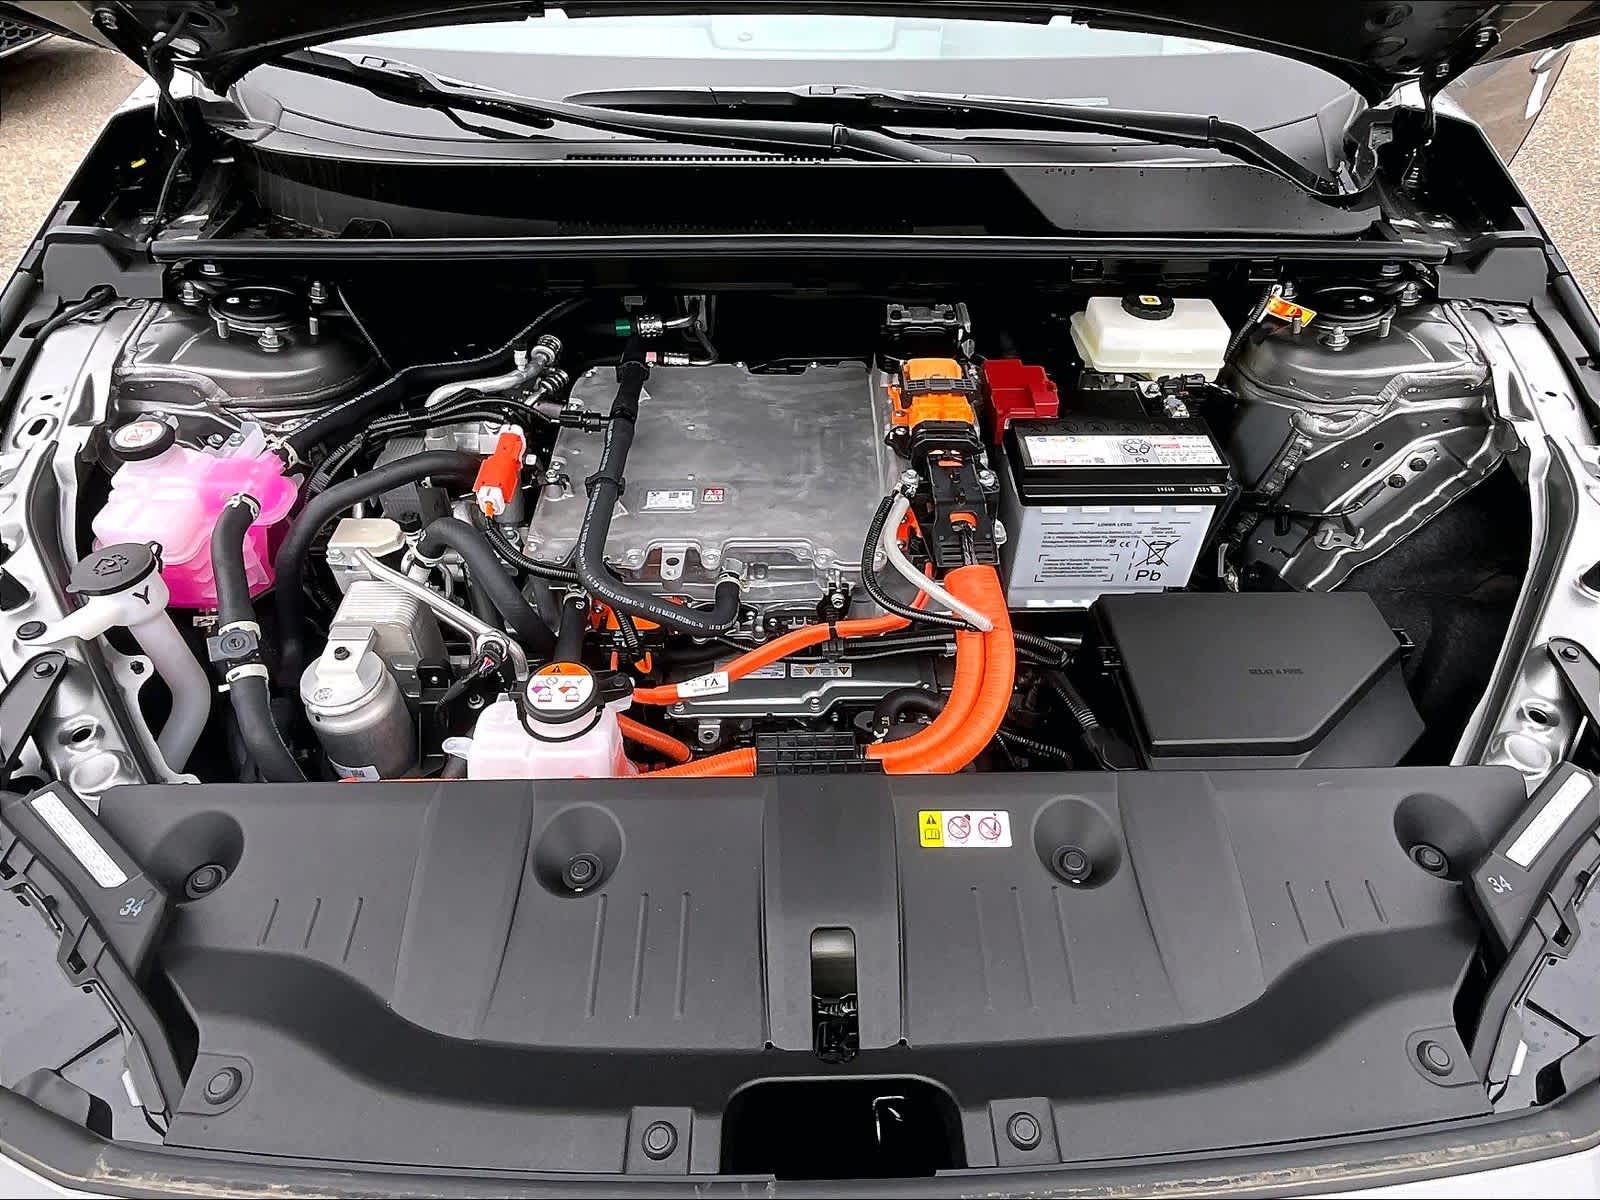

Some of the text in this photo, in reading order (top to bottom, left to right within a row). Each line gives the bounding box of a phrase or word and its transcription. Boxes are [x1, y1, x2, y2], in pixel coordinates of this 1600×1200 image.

[1135, 569, 1161, 581] Pb
[1487, 874, 1513, 893] 34
[119, 897, 145, 917] 34
